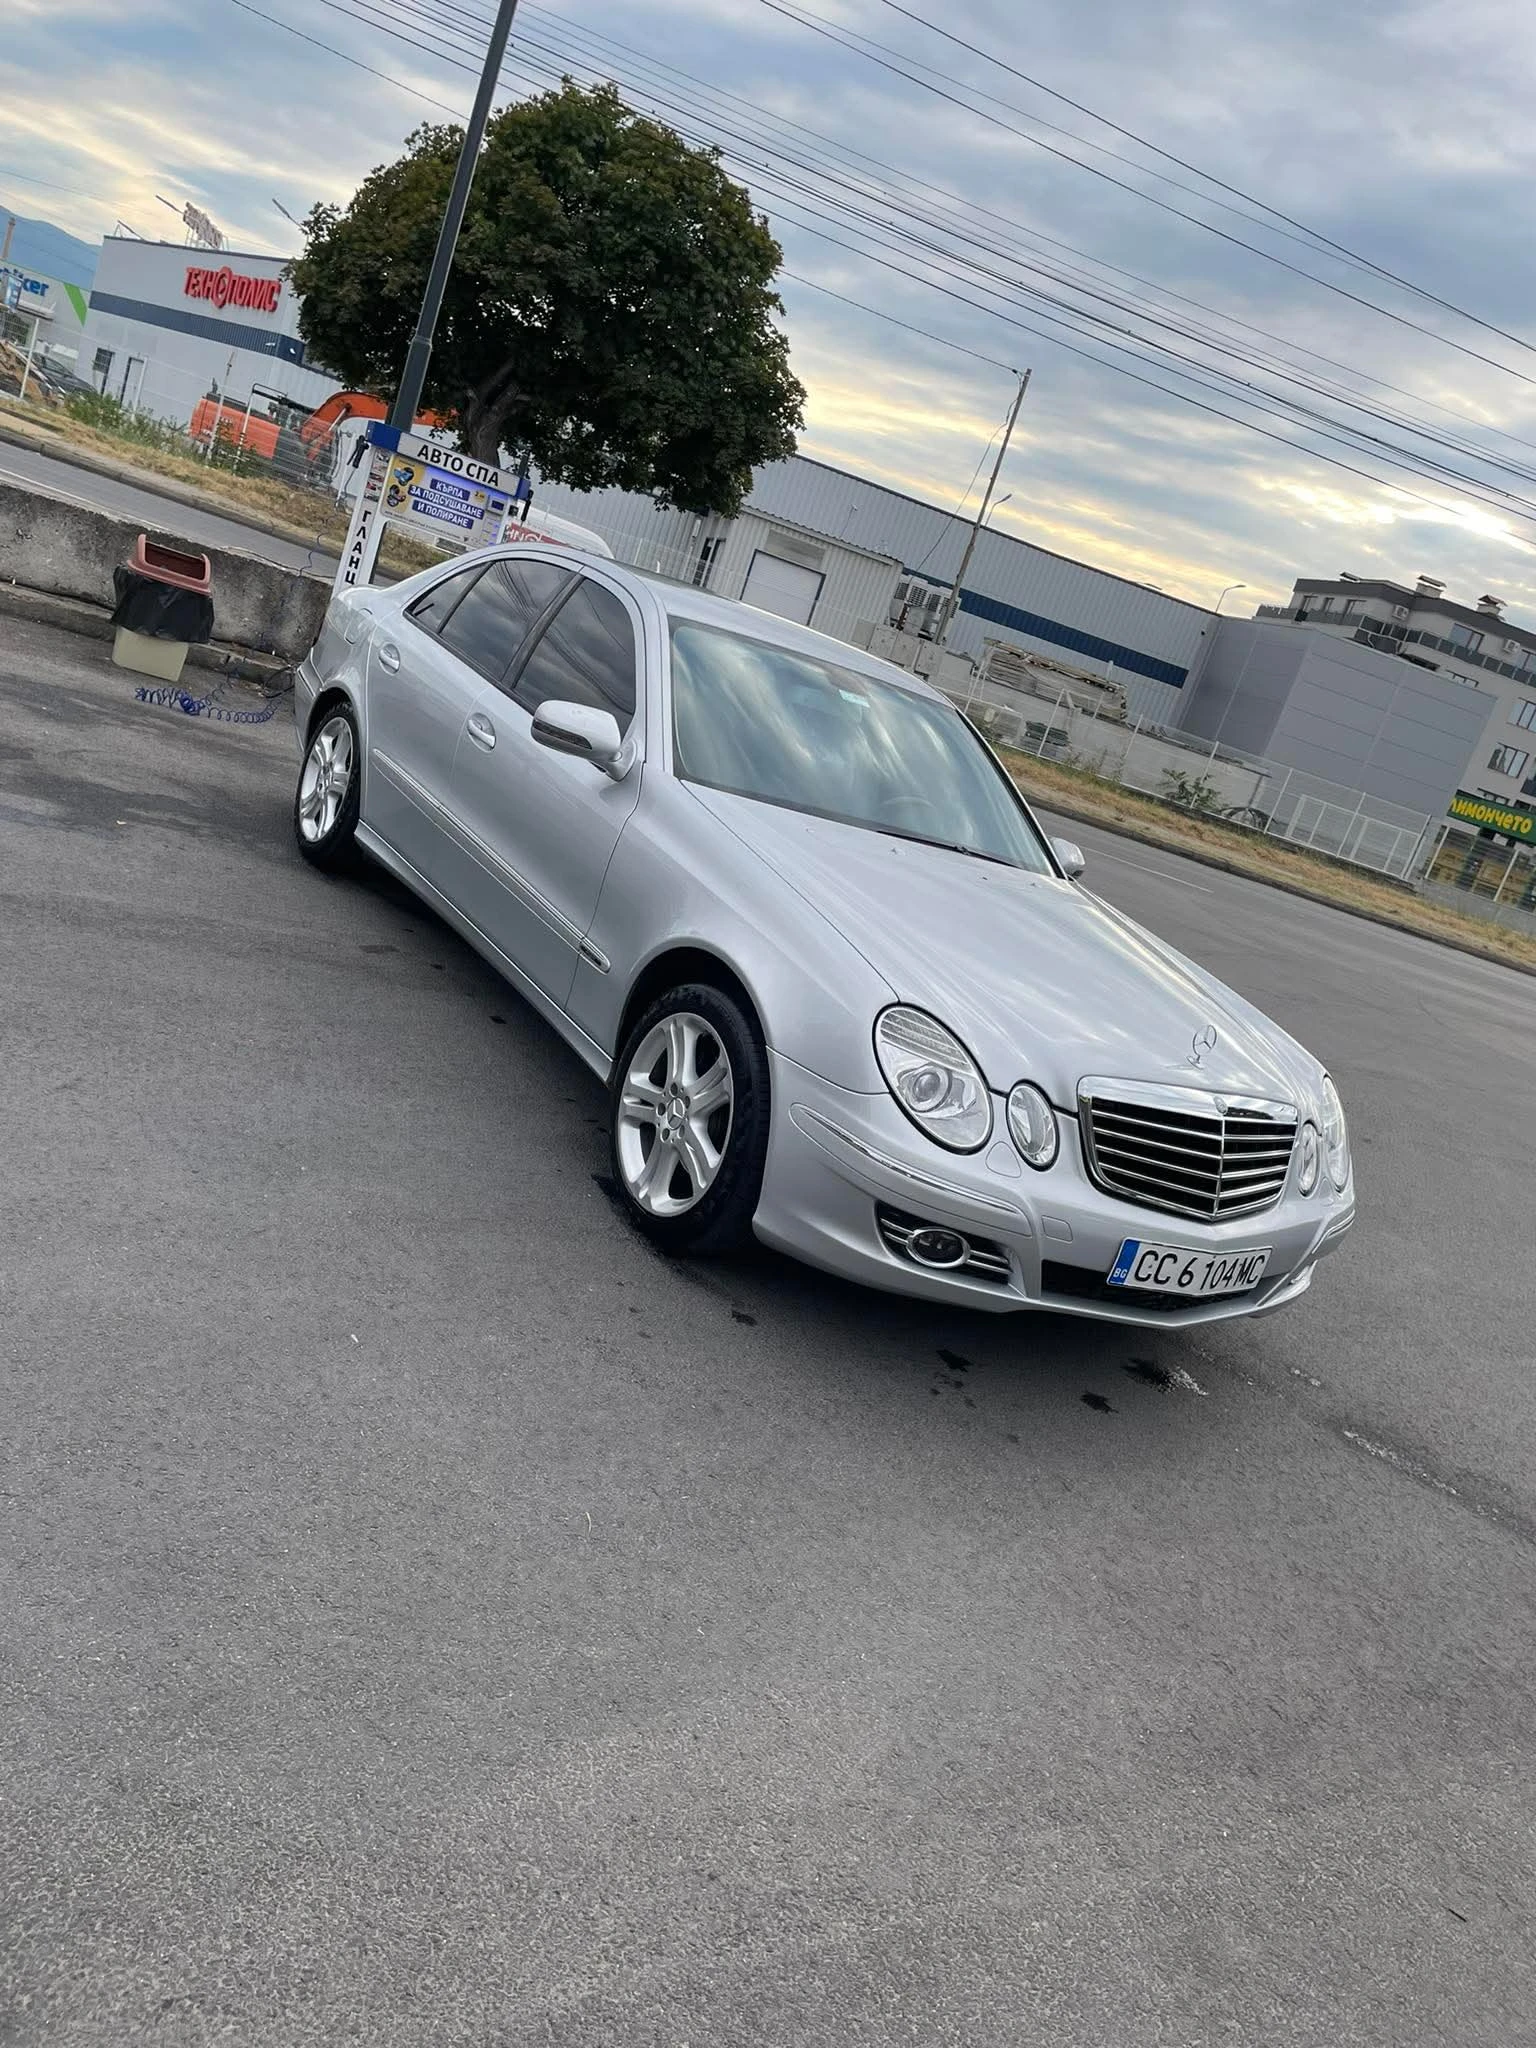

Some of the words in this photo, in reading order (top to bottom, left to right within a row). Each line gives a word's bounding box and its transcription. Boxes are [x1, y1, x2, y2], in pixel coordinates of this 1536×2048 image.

[184, 266, 282, 312] ТЕХНОПОЛИС
[417, 444, 463, 472] АВТО
[466, 463, 499, 487] СПА
[410, 486, 421, 497] ЗА
[422, 489, 482, 518] ПОДСУШАВАНЕ
[436, 481, 463, 498] КЪРПА
[417, 502, 424, 511] И
[425, 505, 470, 527] ПОЛИРАНЕ
[345, 510, 372, 585] ГЛАНЦ
[1113, 1267, 1128, 1279] BG
